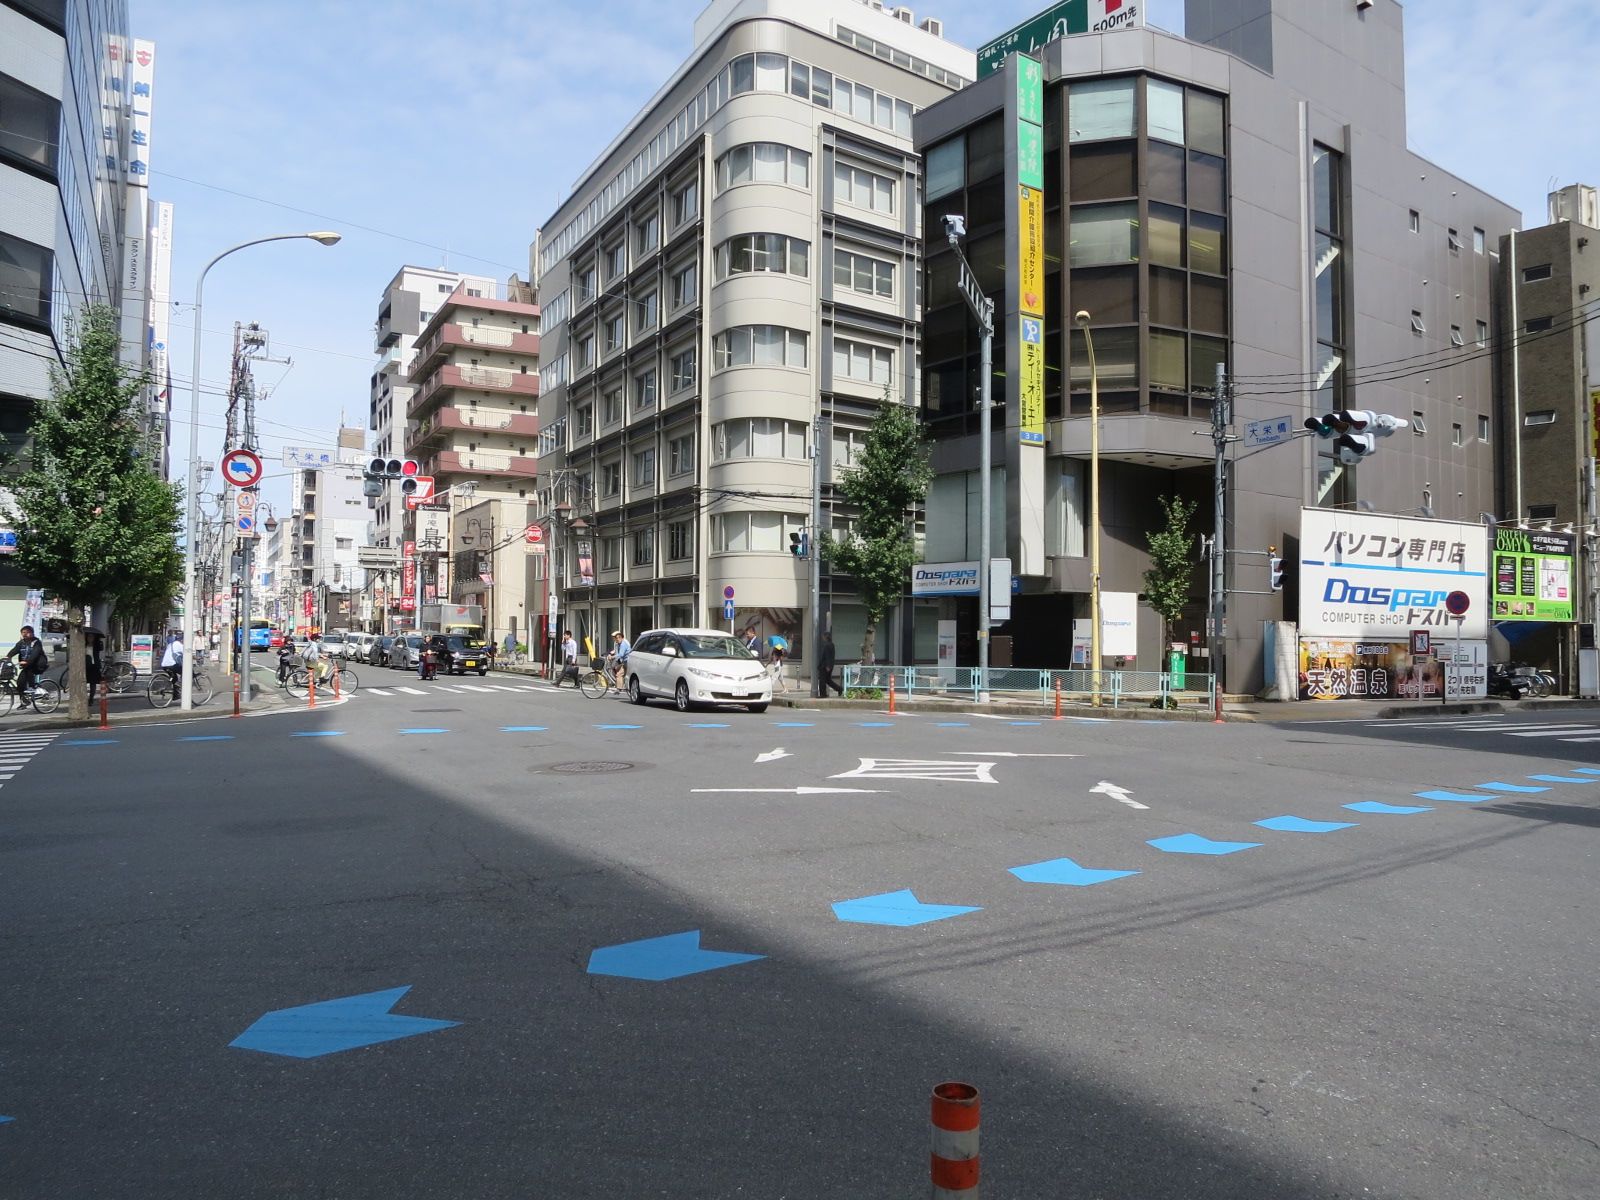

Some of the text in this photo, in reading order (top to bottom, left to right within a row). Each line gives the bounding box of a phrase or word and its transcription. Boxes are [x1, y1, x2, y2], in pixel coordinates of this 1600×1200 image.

[1093, 6, 1137, 32] 500m先
[131, 81, 150, 175] 第一生命
[1025, 320, 1038, 342] TOA
[1249, 422, 1287, 438] 大栄橋
[289, 451, 329, 463] 大栄橋
[1497, 529, 1523, 542] HOTEL
[1324, 531, 1467, 565] パソコン専門店
[915, 570, 977, 581] Dospara
[1322, 578, 1448, 612] Dospar
[1322, 611, 1376, 625] COMPUTER
[1379, 614, 1405, 625] SHOP
[1308, 668, 1388, 697] 天然温泉
